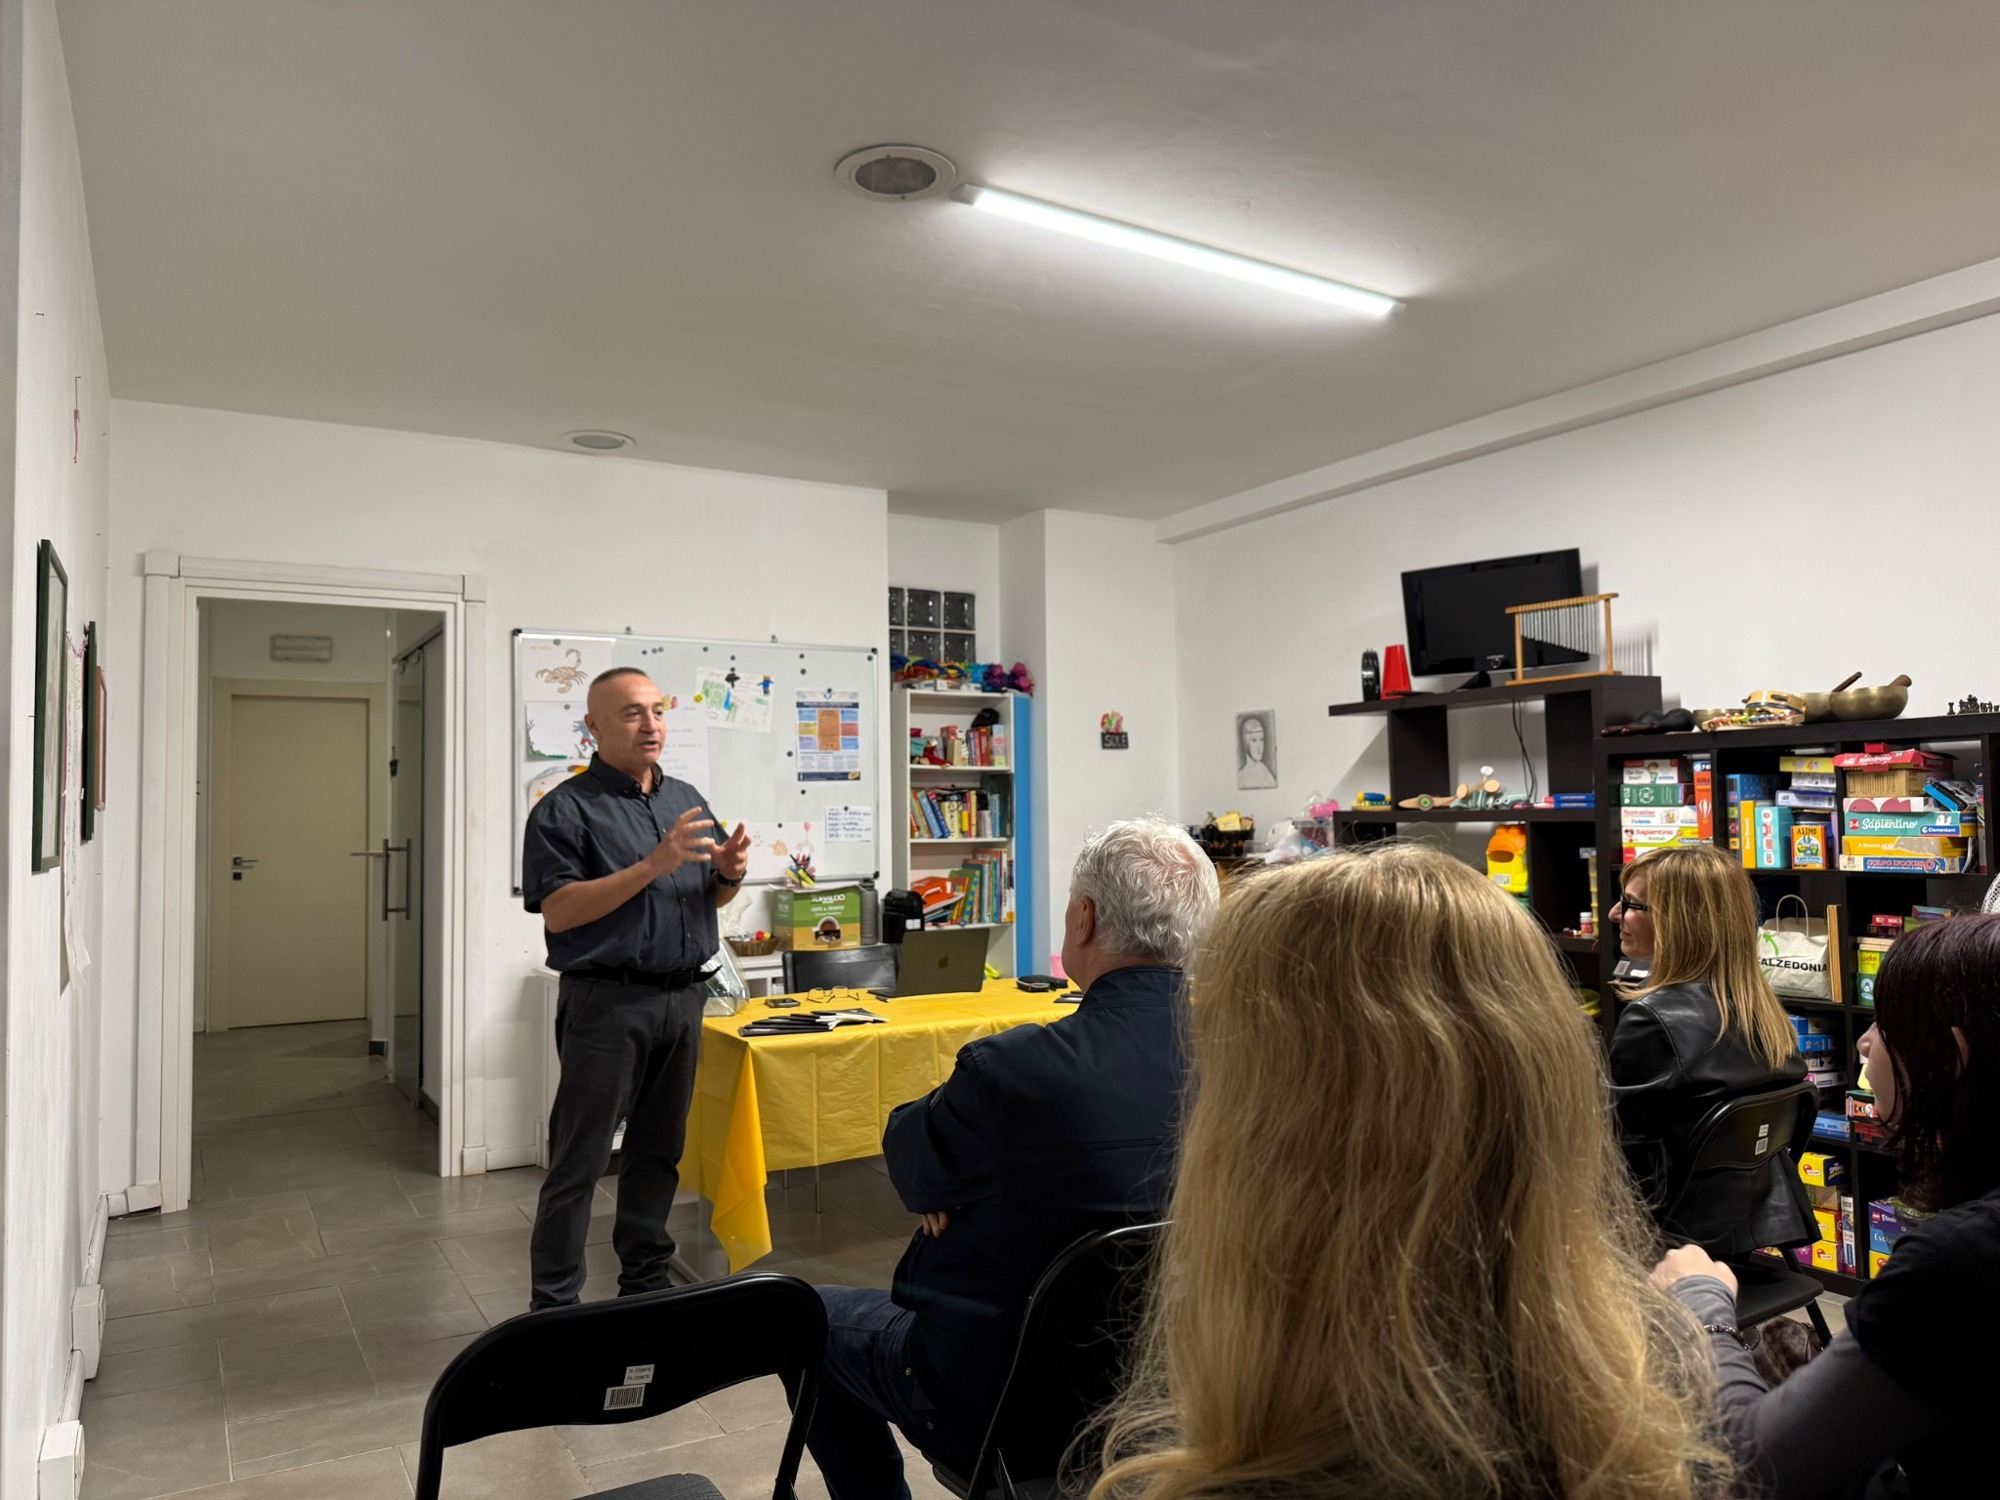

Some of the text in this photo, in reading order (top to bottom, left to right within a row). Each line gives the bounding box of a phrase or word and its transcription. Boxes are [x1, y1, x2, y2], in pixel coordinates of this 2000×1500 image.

[1848, 818, 1917, 831] 2-4 Sapientino
[1797, 827, 1817, 836] ASINO
[1759, 957, 1828, 972] ALZEDONIA
